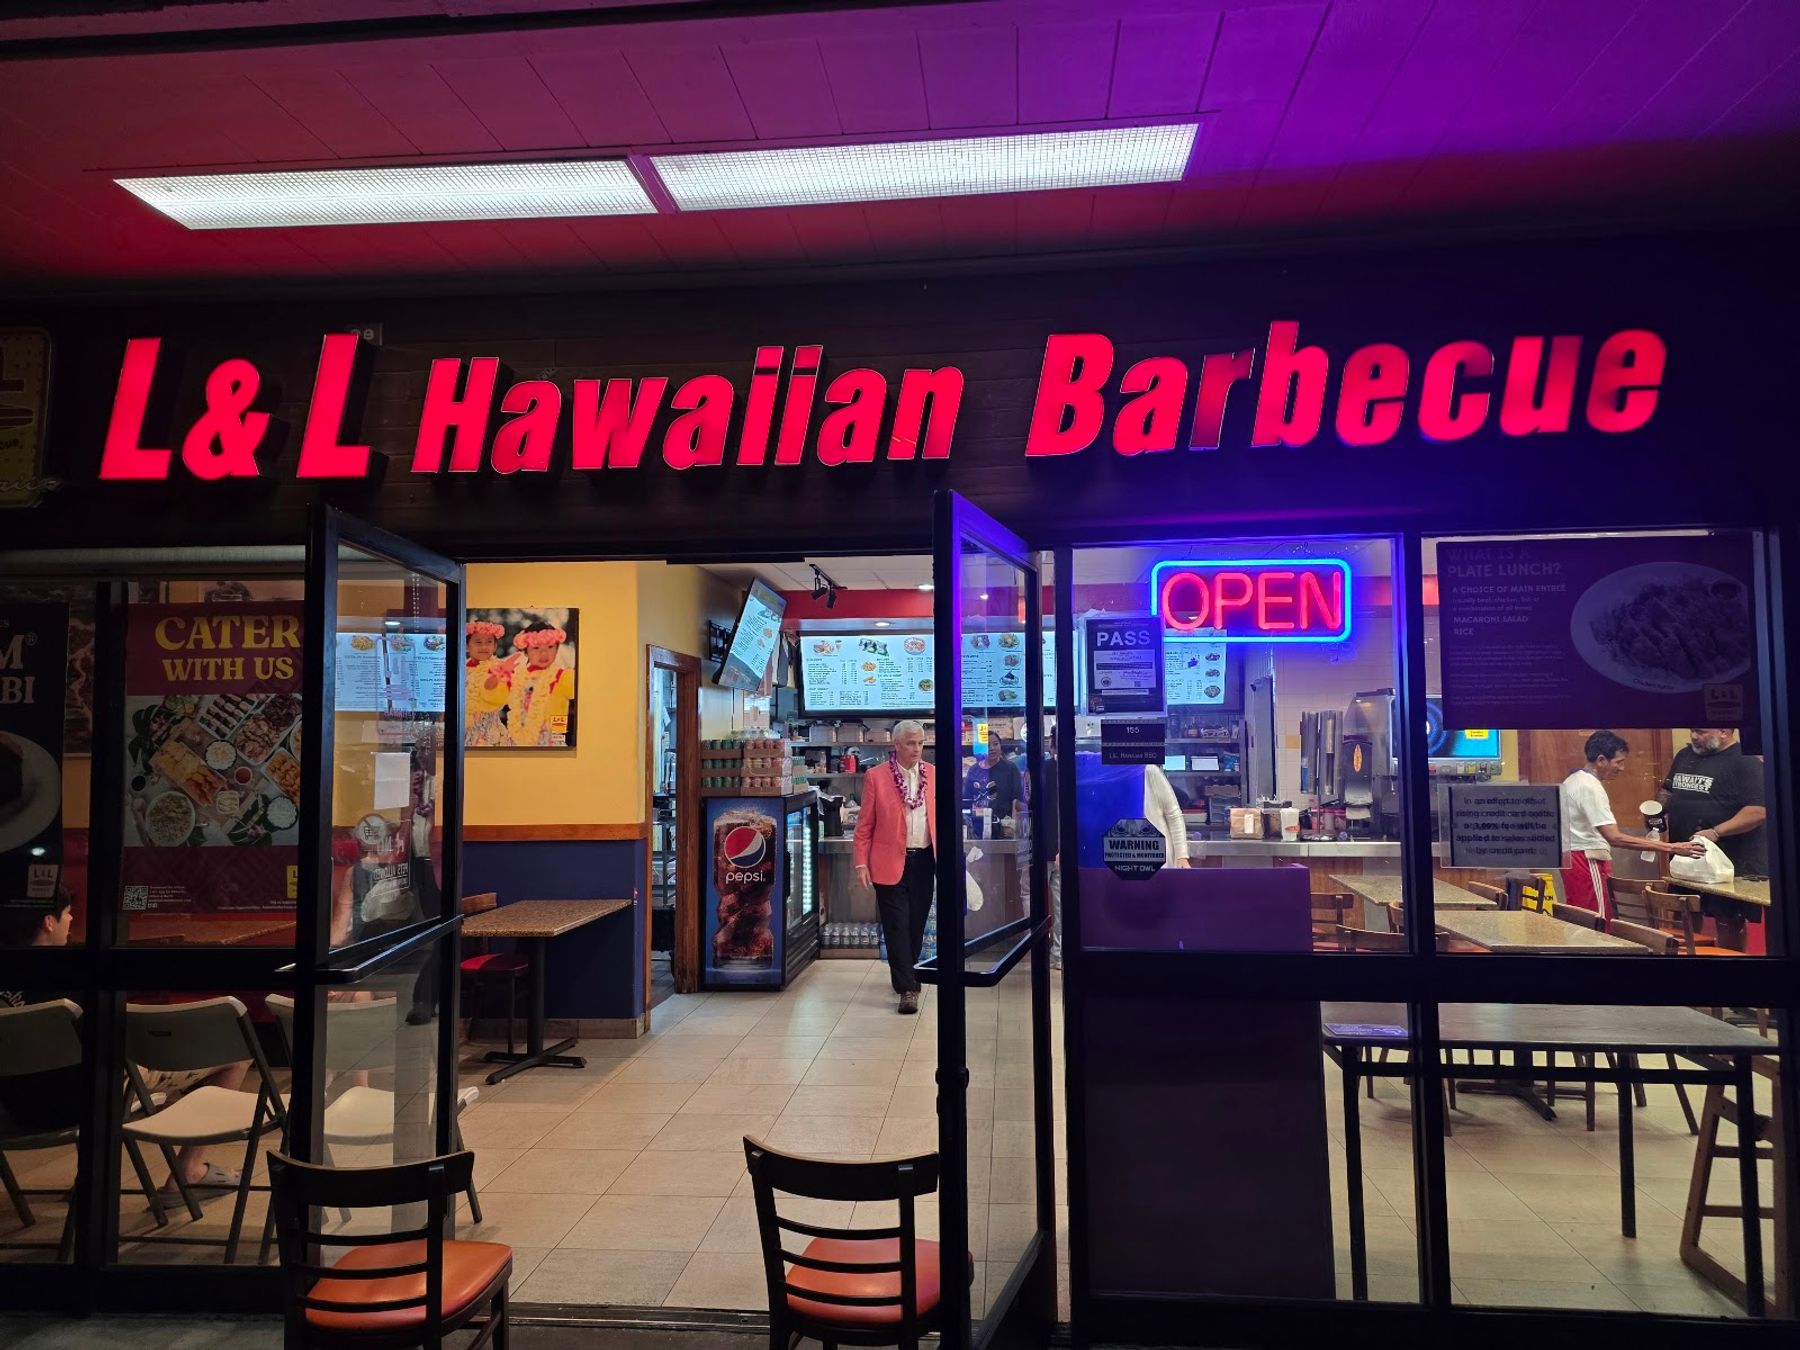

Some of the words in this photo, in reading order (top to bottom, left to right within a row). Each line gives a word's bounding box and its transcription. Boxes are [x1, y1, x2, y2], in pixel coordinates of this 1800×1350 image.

[410, 344, 963, 474] Hawaiian
[1024, 321, 1667, 458] Barbecue
[1447, 564, 1493, 577] PLATE
[1498, 562, 1561, 576] LUNCH?
[1510, 585, 1534, 593] MAIN
[1162, 571, 1342, 631] OPEN
[1453, 616, 1500, 624] MACARONI
[155, 615, 301, 650] CATER
[1096, 631, 1151, 646] PASS
[1453, 627, 1473, 636] RICE
[162, 657, 245, 681] WITH
[253, 656, 295, 681] US
[1109, 840, 1160, 850] WARNING
[725, 869, 764, 884] pepsi
